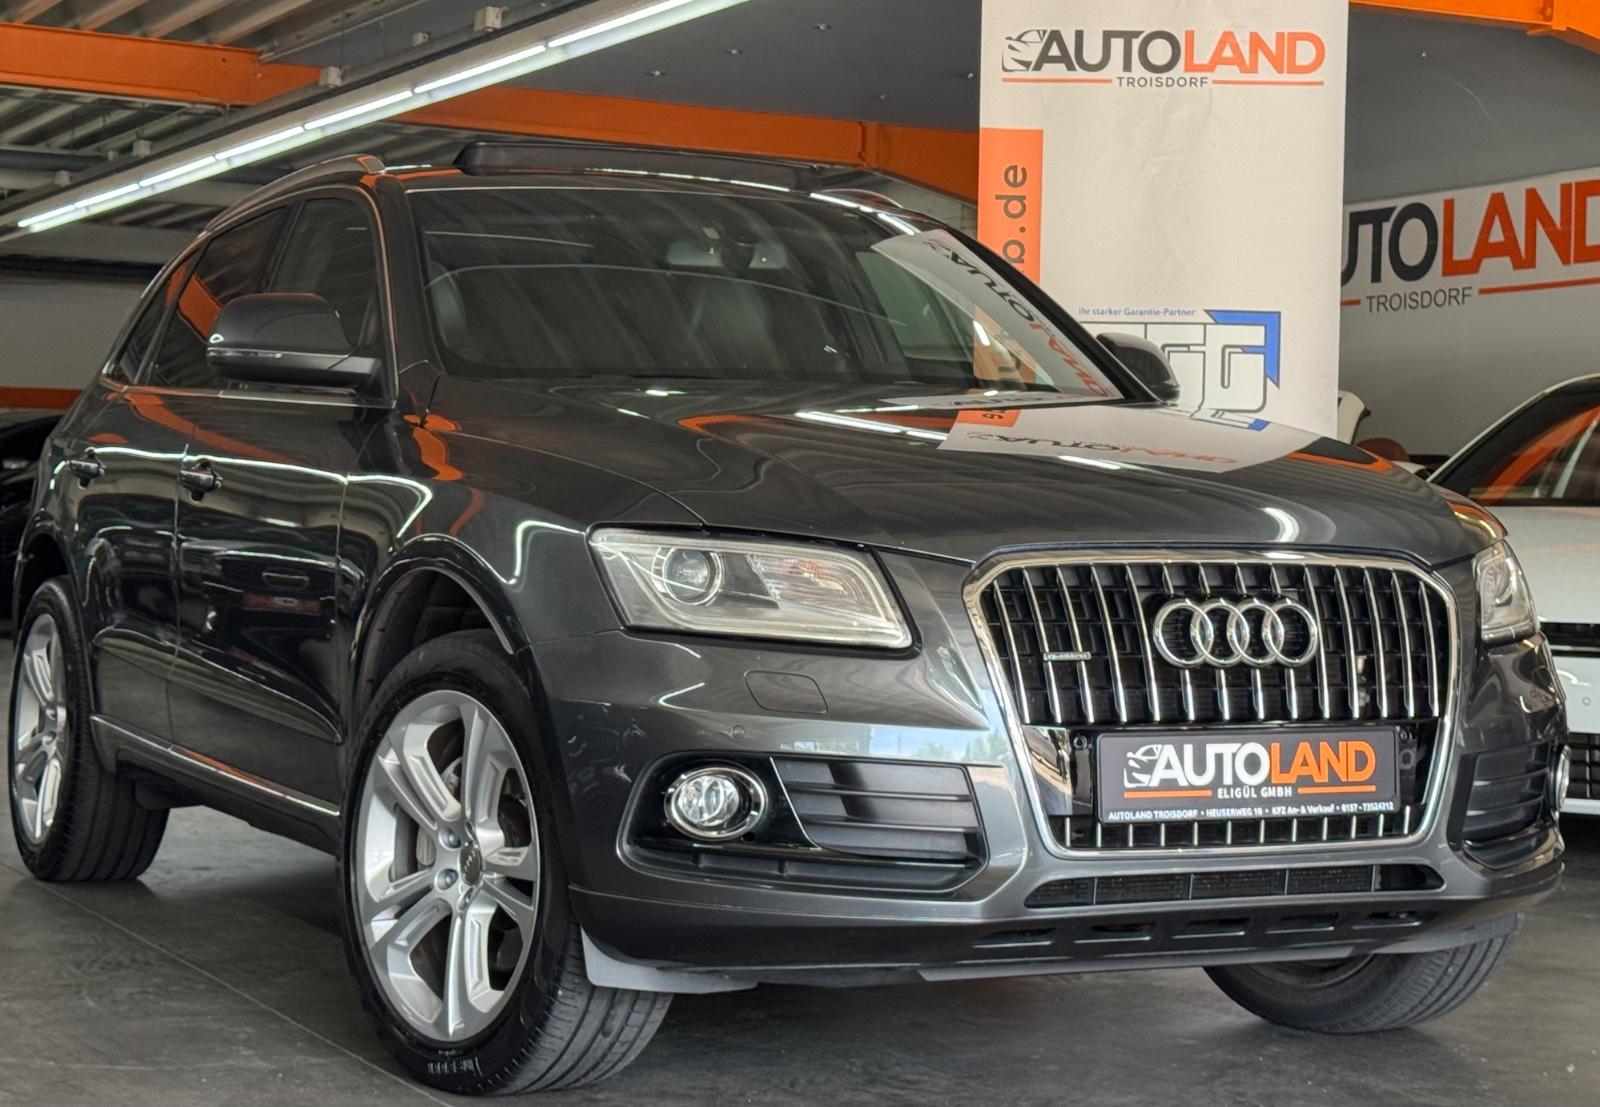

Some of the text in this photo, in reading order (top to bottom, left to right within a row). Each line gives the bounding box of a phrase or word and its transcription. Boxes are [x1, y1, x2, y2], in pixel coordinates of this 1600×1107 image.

[1031, 29, 1326, 74] AUTOLAND
[1116, 76, 1208, 88] TROISDORF
[1366, 286, 1473, 312] TROISDORF
[1092, 308, 1122, 317] starker
[1123, 308, 1196, 318] Garantie-Partner
[1148, 741, 1376, 788] AUTOLAND
[1217, 786, 1292, 799] ELIGÜL GMBH
[1108, 811, 1153, 821] AUTOLAND
[1154, 809, 1198, 819] TROISDORF
[1272, 806, 1287, 816] KFZ
[1307, 803, 1335, 814] Verkauf
